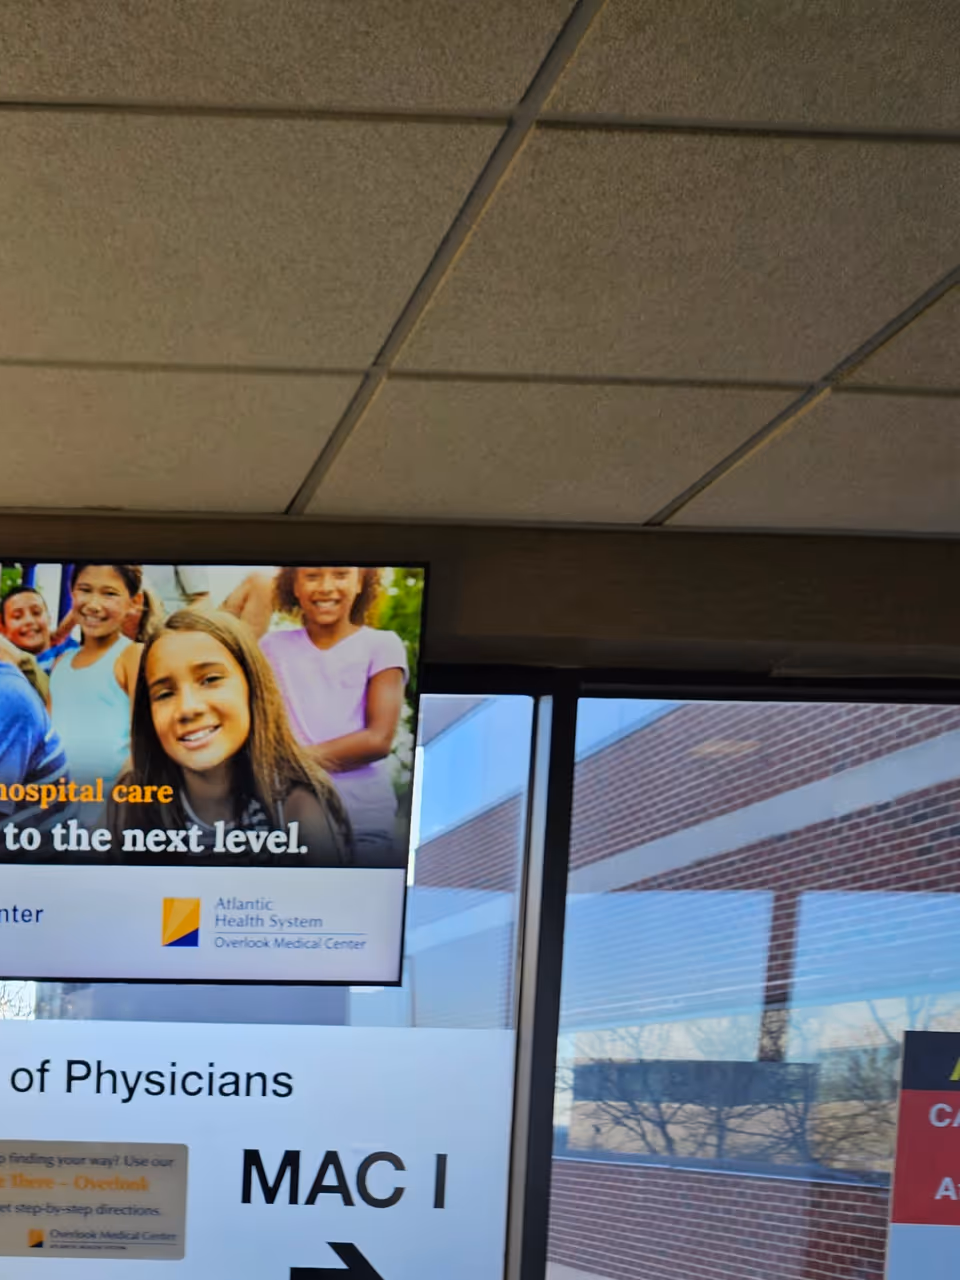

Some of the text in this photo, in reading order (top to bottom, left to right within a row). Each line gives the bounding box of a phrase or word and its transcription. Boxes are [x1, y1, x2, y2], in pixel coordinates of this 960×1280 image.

[111, 782, 174, 804] care
[3, 820, 308, 854] to the next level.
[215, 897, 274, 911] Atlantic
[215, 914, 323, 931] Health System
[215, 937, 367, 950] Overlook Medical Center
[11, 1060, 50, 1093] of
[67, 1060, 294, 1103] Physicians
[8, 1152, 54, 1168] finding
[57, 1156, 87, 1168] your
[89, 1154, 119, 1168] way?
[124, 1155, 149, 1167] Use
[151, 1157, 174, 1167] our
[10, 1172, 55, 1189] There
[73, 1174, 149, 1191] Overlook
[242, 1149, 446, 1209] MAC I
[15, 1202, 93, 1219] step-by-step
[49, 1229, 97, 1239] Overlook
